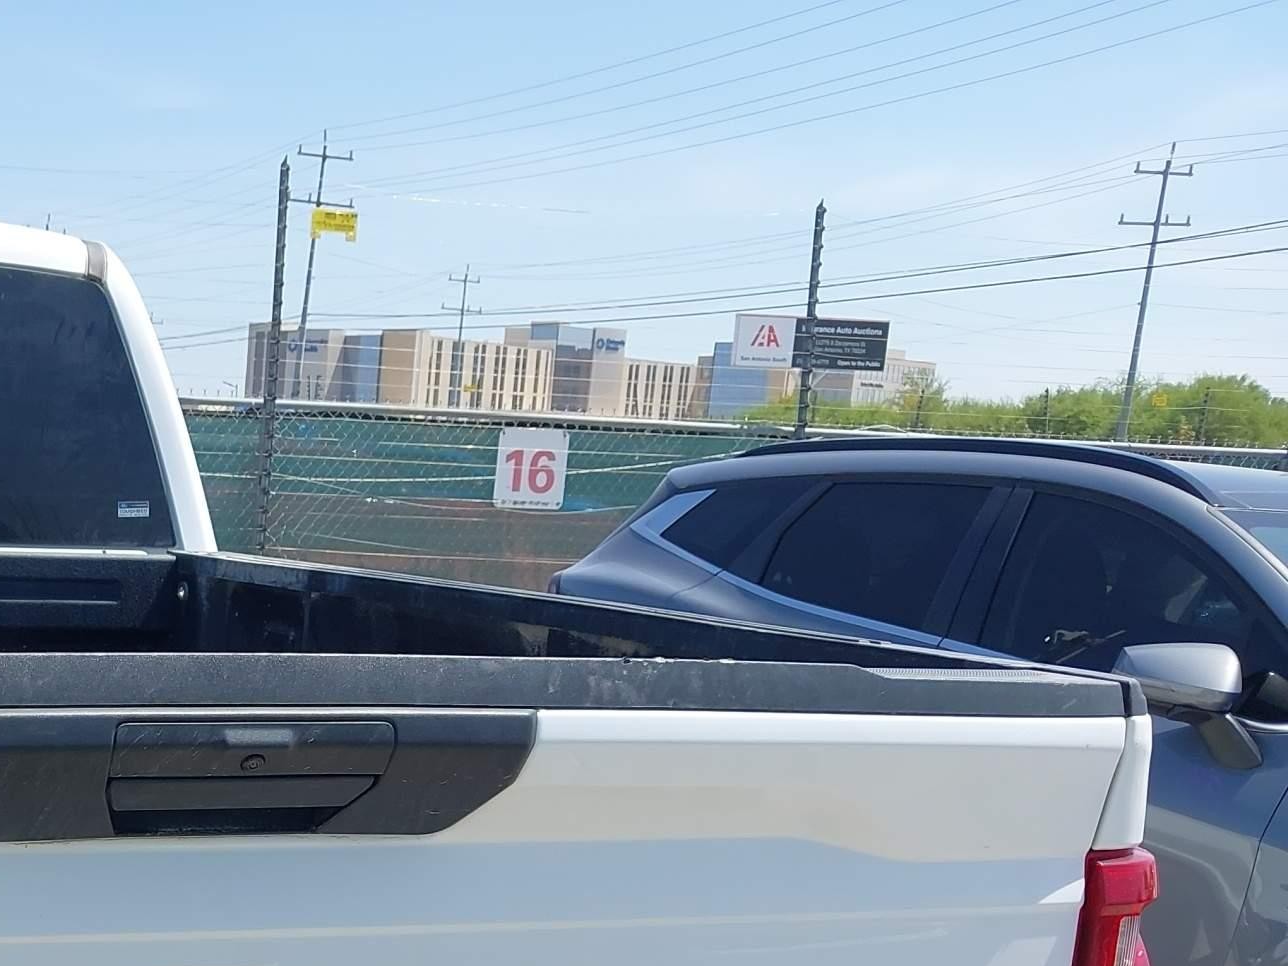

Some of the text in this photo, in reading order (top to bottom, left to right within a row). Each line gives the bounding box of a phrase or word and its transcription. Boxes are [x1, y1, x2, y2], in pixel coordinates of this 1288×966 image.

[836, 326, 852, 334] Auto
[853, 327, 882, 336] Auctions
[505, 449, 556, 494] 16
